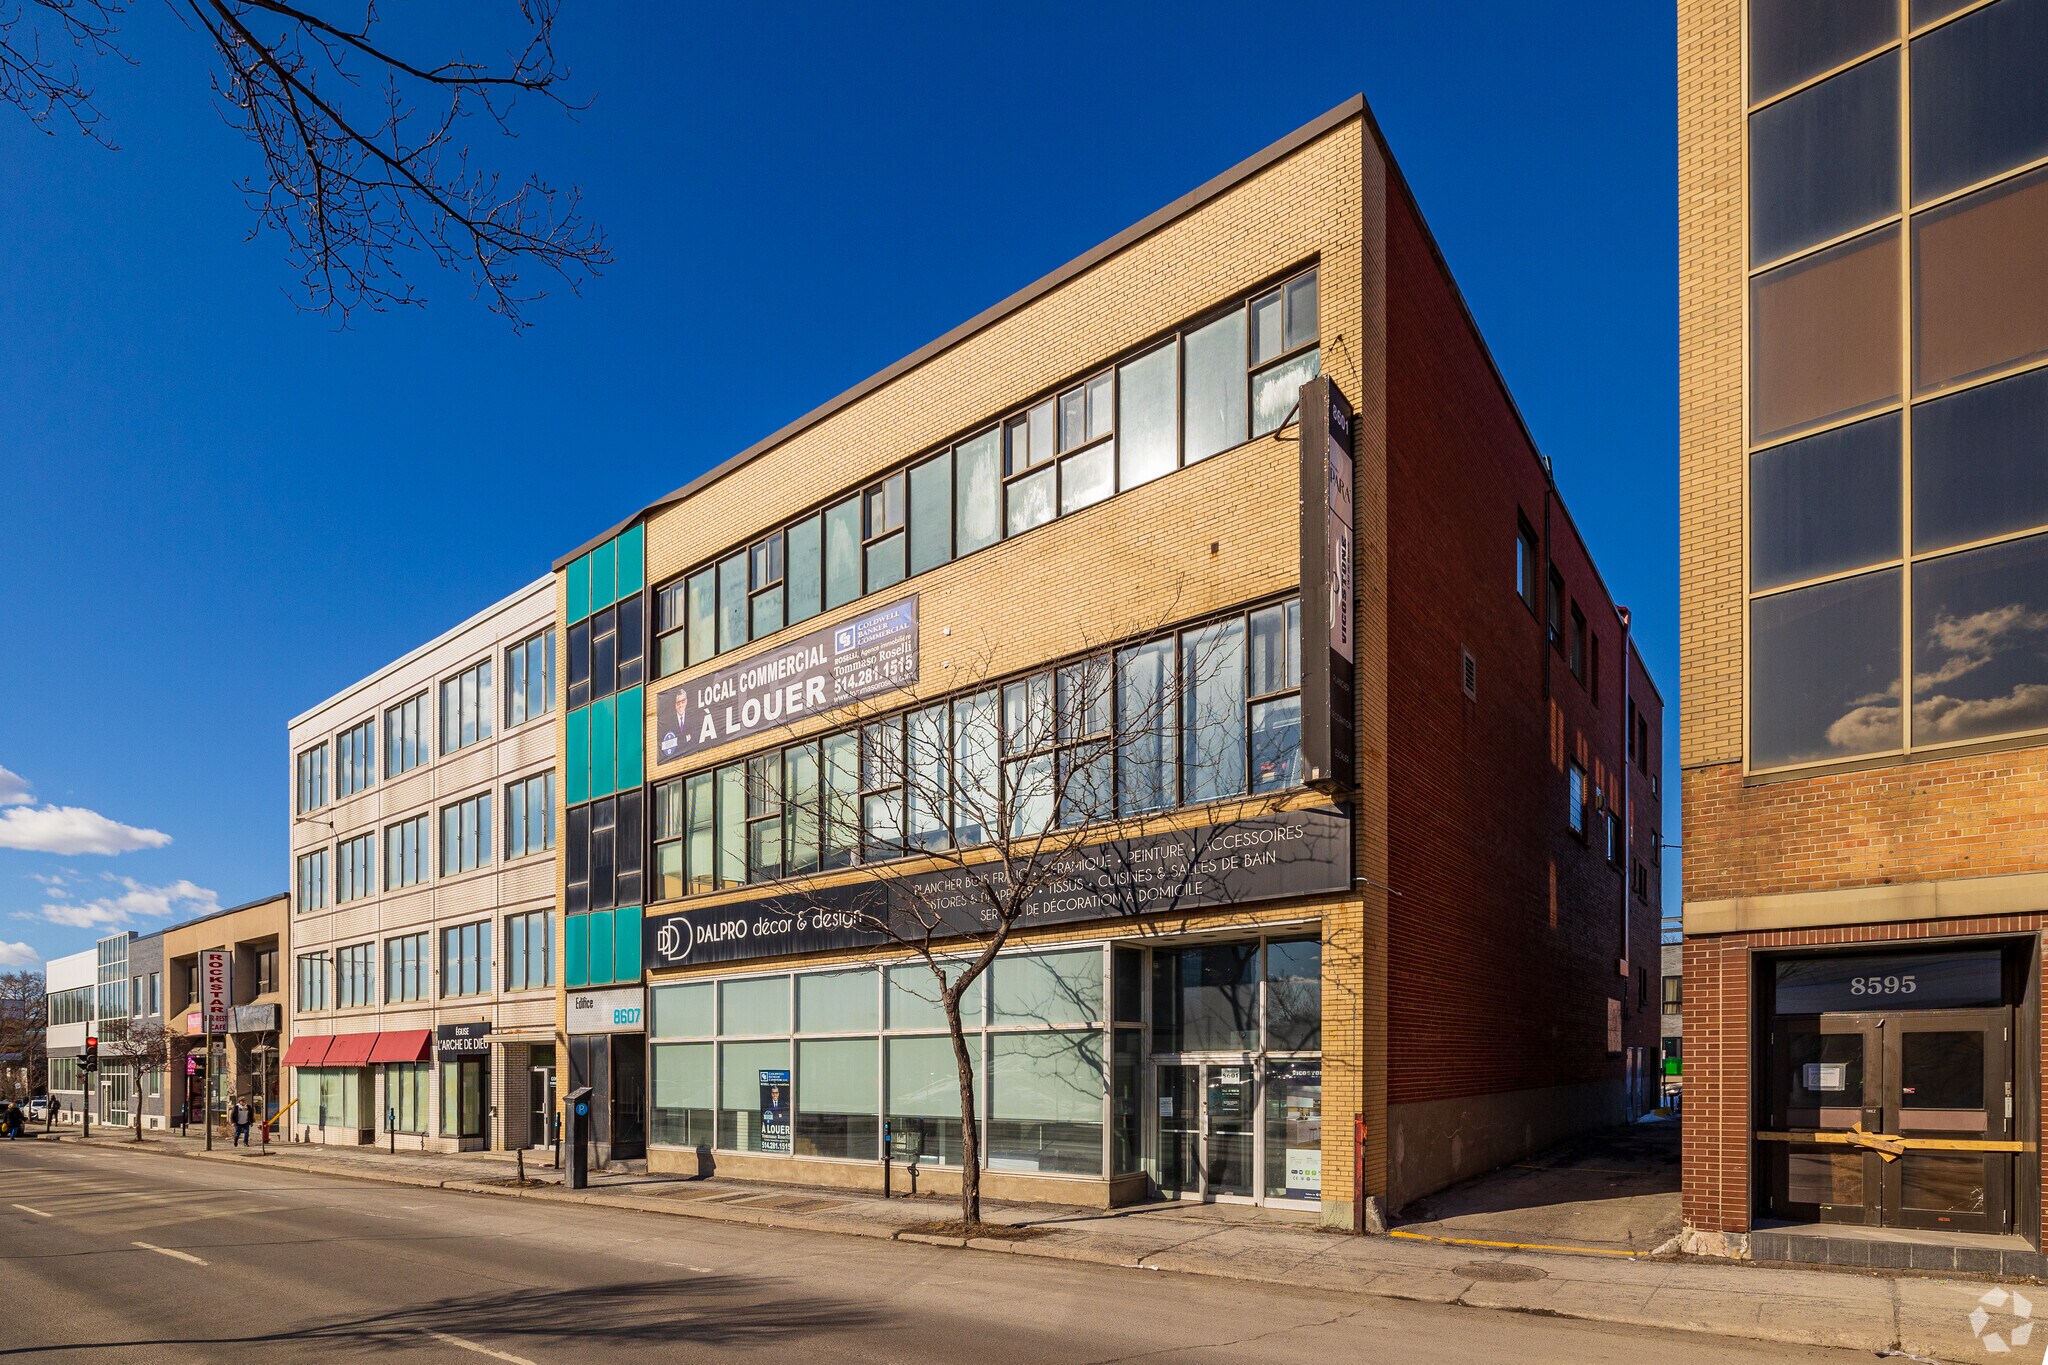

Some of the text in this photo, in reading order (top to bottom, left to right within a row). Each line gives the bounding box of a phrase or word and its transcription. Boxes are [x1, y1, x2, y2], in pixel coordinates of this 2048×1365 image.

[1332, 404, 1349, 436] 8601
[858, 611, 900, 631] COLDWELL
[858, 622, 888, 638] BANKER
[858, 623, 910, 645] COMMERCIAL
[834, 640, 912, 677] Tommaso Roselli
[861, 645, 880, 656] Agence
[697, 644, 828, 708] LOCAL COMMERCIAL
[834, 654, 913, 694] 514.281.1515
[698, 675, 827, 744] À LOUER
[914, 878, 963, 896] PLANCHER
[993, 868, 1027, 884] FRC
[1042, 854, 1112, 877] RAMIQUE
[1128, 843, 1185, 864] PEINTURE
[1204, 824, 1304, 852] ACCESSOIRES
[931, 895, 967, 910] STORES
[1049, 879, 1084, 895] TISSUS
[1098, 868, 1153, 888] CUISINES
[1156, 866, 1166, 880] &
[1171, 859, 1217, 878] SALLES
[1222, 855, 1239, 871] DE
[1244, 850, 1276, 867] BAIN
[1026, 902, 1040, 916] DE
[1044, 893, 1122, 914] DÉCORATION
[1126, 888, 1135, 904] À
[1138, 881, 1203, 901] DOMICILE
[697, 919, 748, 944] DALPRO
[752, 917, 793, 937] décor
[796, 910, 807, 932] &
[812, 908, 863, 932] design
[208, 954, 224, 1013] ROCKSTAR
[1850, 975, 1918, 996] 8595
[204, 1015, 228, 1023] BR-REST
[211, 1023, 227, 1031] CAFÉ
[613, 1008, 641, 1025] 8607
[438, 1039, 463, 1051] L'ARCHE
[464, 1039, 472, 1050] DE
[578, 1104, 585, 1113] P
[766, 1124, 791, 1135] LOUER
